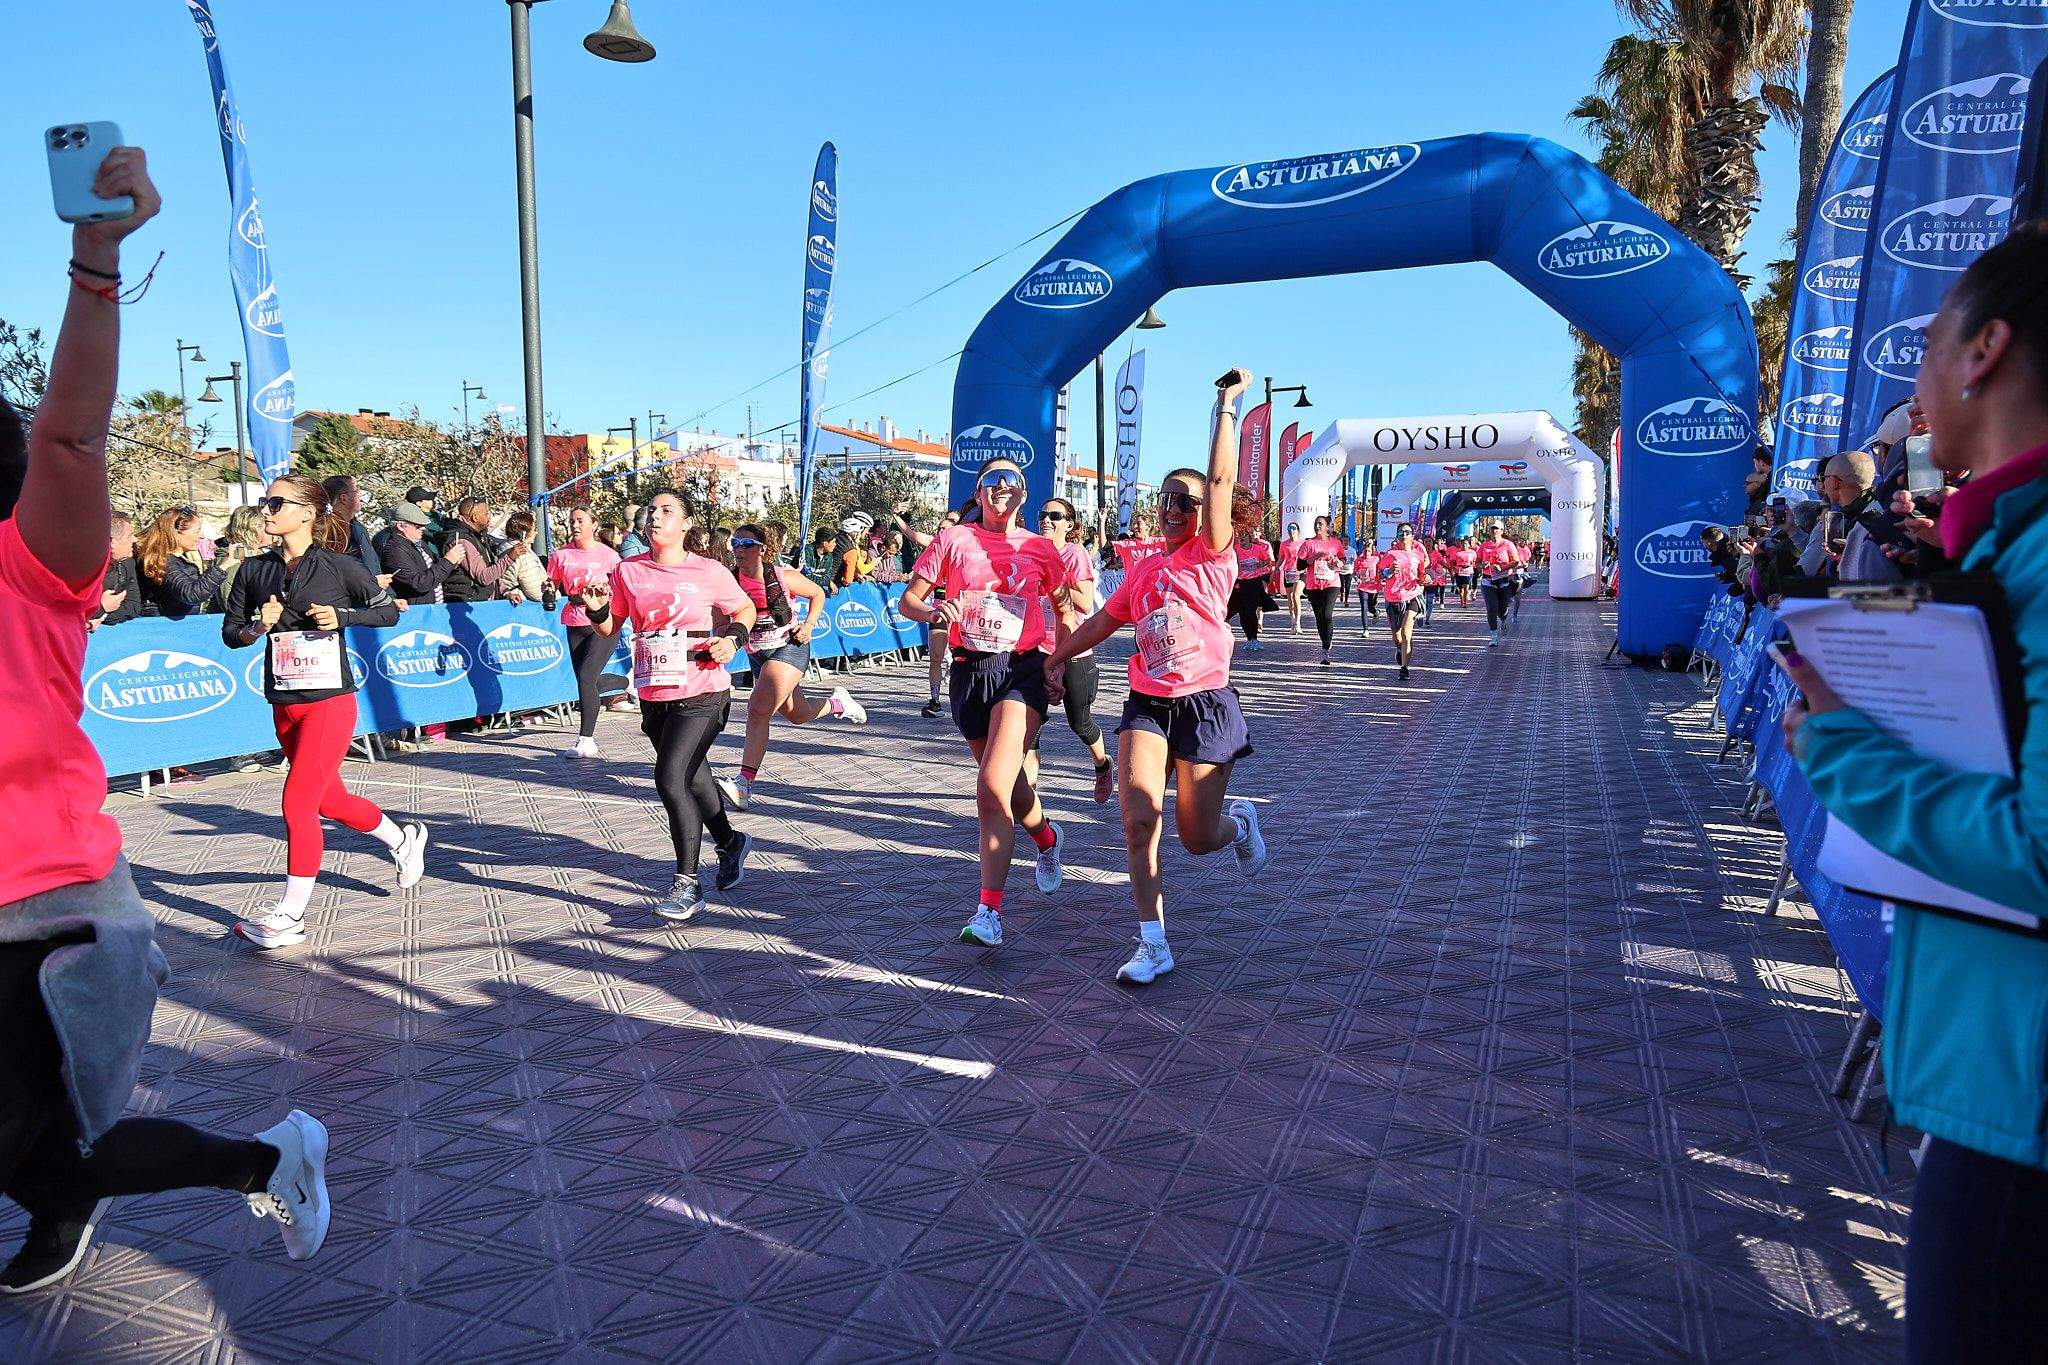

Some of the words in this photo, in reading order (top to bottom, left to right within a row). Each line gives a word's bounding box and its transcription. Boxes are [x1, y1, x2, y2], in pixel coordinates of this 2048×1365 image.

[1948, 102, 2006, 111] CENTRAL
[1224, 151, 1404, 194] ASTURIANA
[1924, 221, 1982, 229] CENTRAL
[1566, 240, 1610, 251] CENTRAL
[1613, 236, 1655, 244] LECHERA
[1548, 243, 1662, 270] ASTURIANA
[1019, 281, 1105, 298] ASTURIANA
[1661, 417, 1704, 426] CENTRAL
[1373, 423, 1499, 453] OYSHO
[1643, 421, 1746, 444] ASTURIANA
[953, 443, 1028, 464] ASTURIANA
[1247, 422, 1263, 488] Santander
[1301, 457, 1338, 466] OYSHO
[1536, 447, 1577, 459] OYSHO
[1472, 495, 1536, 503] VOLVO
[1556, 551, 1594, 561] OYSHO
[978, 617, 1002, 630] 016
[1153, 635, 1176, 652] 016
[487, 644, 560, 665] ASTURIANA
[118, 674, 169, 687] CENTRAL
[171, 668, 219, 680] LECHERA
[98, 678, 229, 711] ASTURIANA
